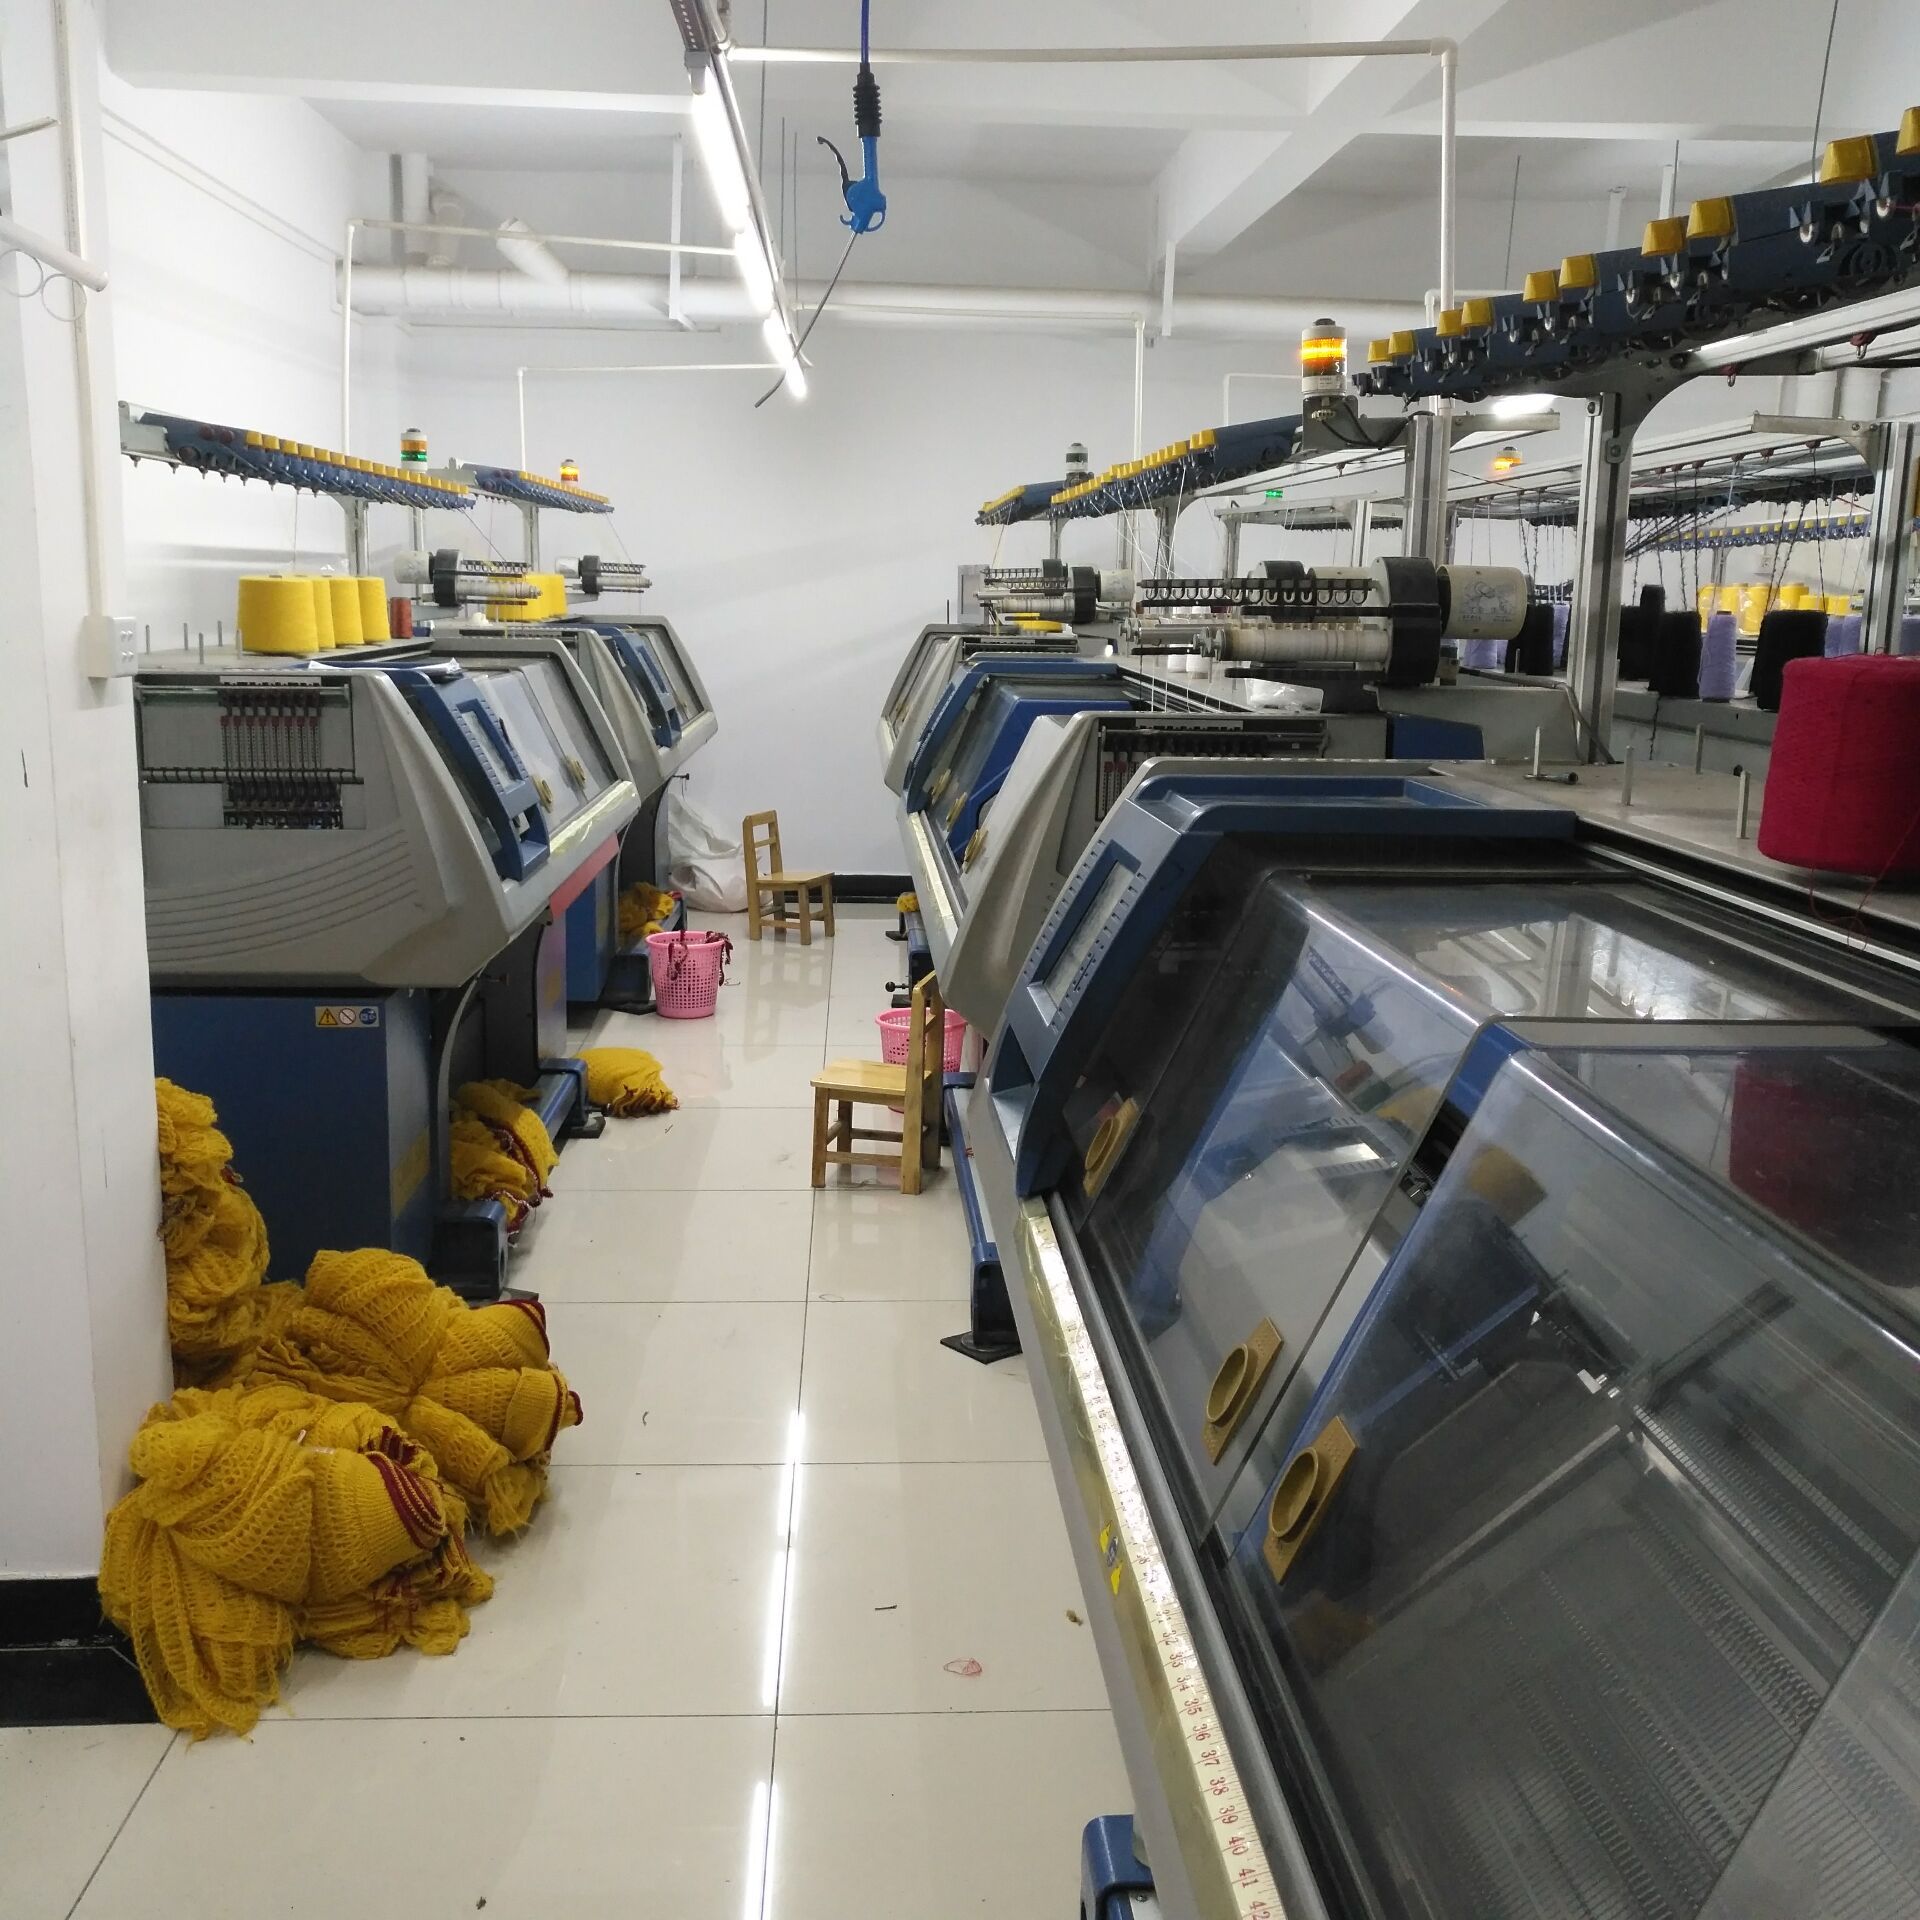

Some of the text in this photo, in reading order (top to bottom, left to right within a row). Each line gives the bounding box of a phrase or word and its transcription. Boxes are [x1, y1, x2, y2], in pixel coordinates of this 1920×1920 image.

[1162, 1630, 1179, 1646] 32
[1169, 1652, 1184, 1668] 33
[1176, 1674, 1194, 1692] 34
[1184, 1698, 1202, 1715] 35
[1192, 1723, 1211, 1741] 36
[1201, 1749, 1220, 1766] 37
[1209, 1776, 1229, 1796] 38
[1219, 1805, 1238, 1824] 39
[1228, 1836, 1248, 1856] 40
[1238, 1868, 1259, 1889] 41
[1249, 1900, 1270, 1920] 42
